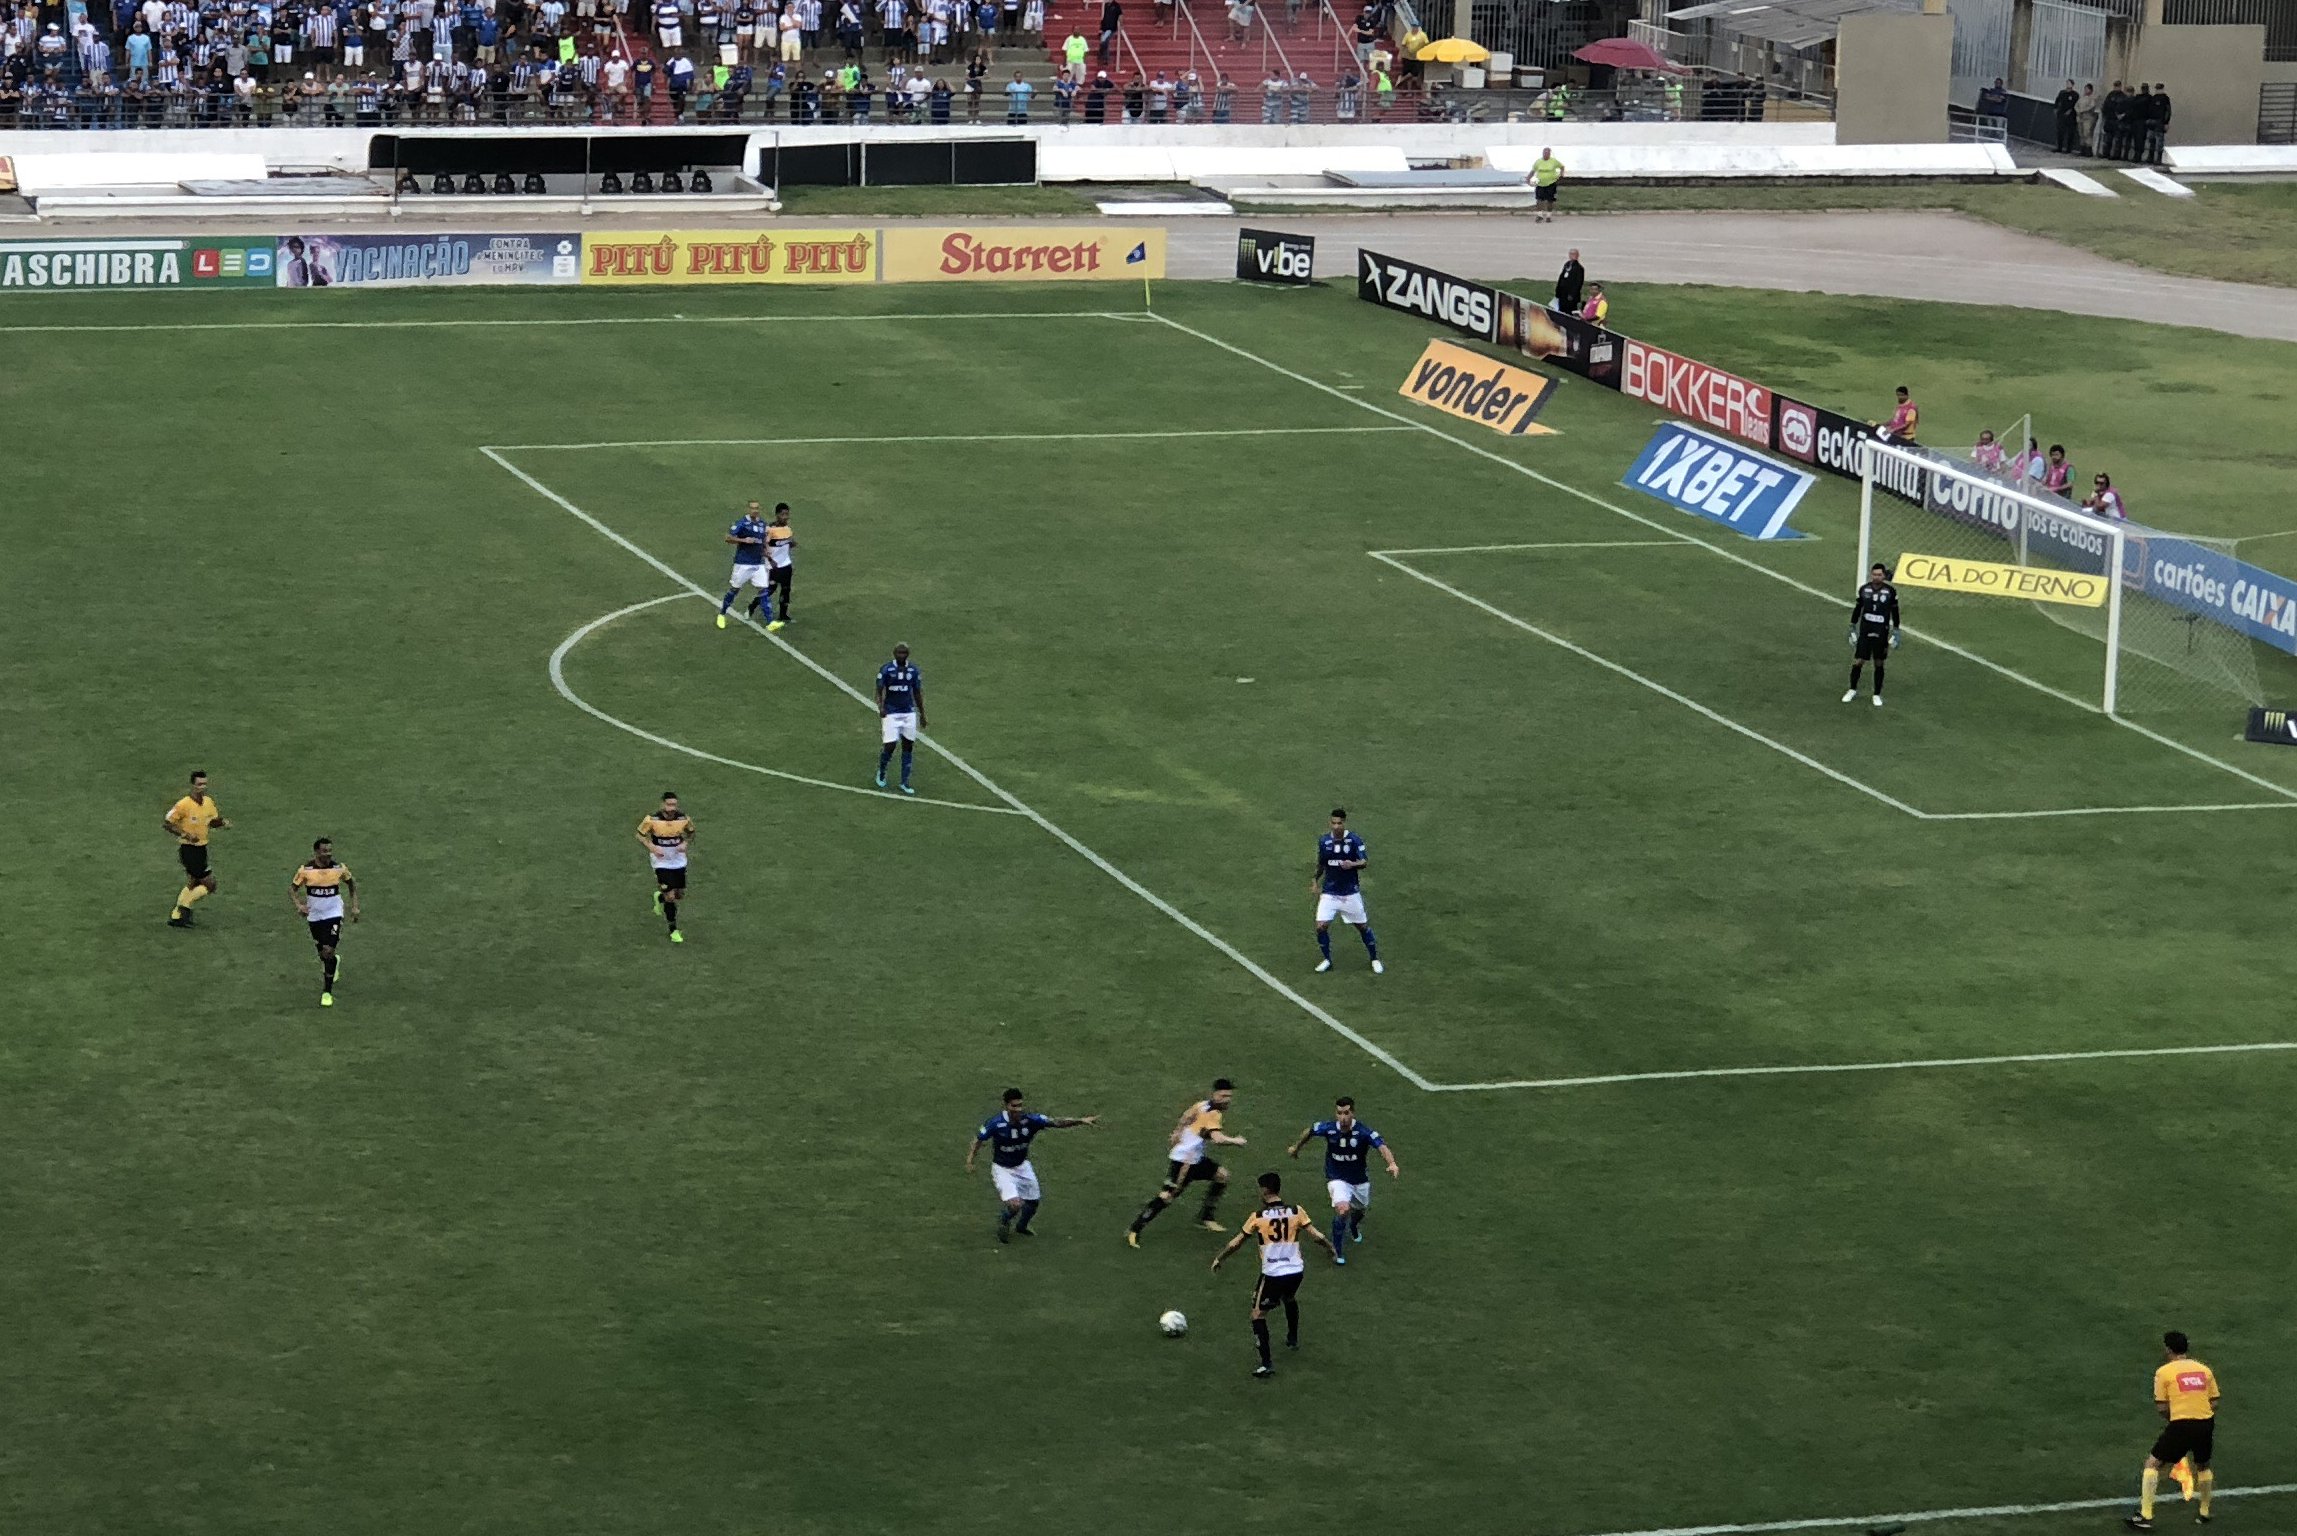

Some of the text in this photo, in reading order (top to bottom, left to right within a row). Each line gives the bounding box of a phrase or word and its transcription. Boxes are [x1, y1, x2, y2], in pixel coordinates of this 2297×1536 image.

[333, 236, 470, 283] VACINAÇÃO
[490, 239, 530, 250] CONTRA
[590, 232, 872, 276] PITÚ PITÚ PITÚ
[940, 232, 1101, 274] Starrett
[2, 252, 181, 286] ASCHIBRA
[1386, 265, 1491, 334] ZANGS
[1412, 358, 1529, 424] vonder
[1637, 434, 1785, 522] 1XBET
[2060, 523, 2103, 556] cabos
[1905, 558, 2095, 599] CIA. DO TERNO
[2153, 559, 2296, 637] cartões CAIXA
[1268, 1217, 1289, 1243] 31
[2180, 1376, 2205, 1387] TCL
